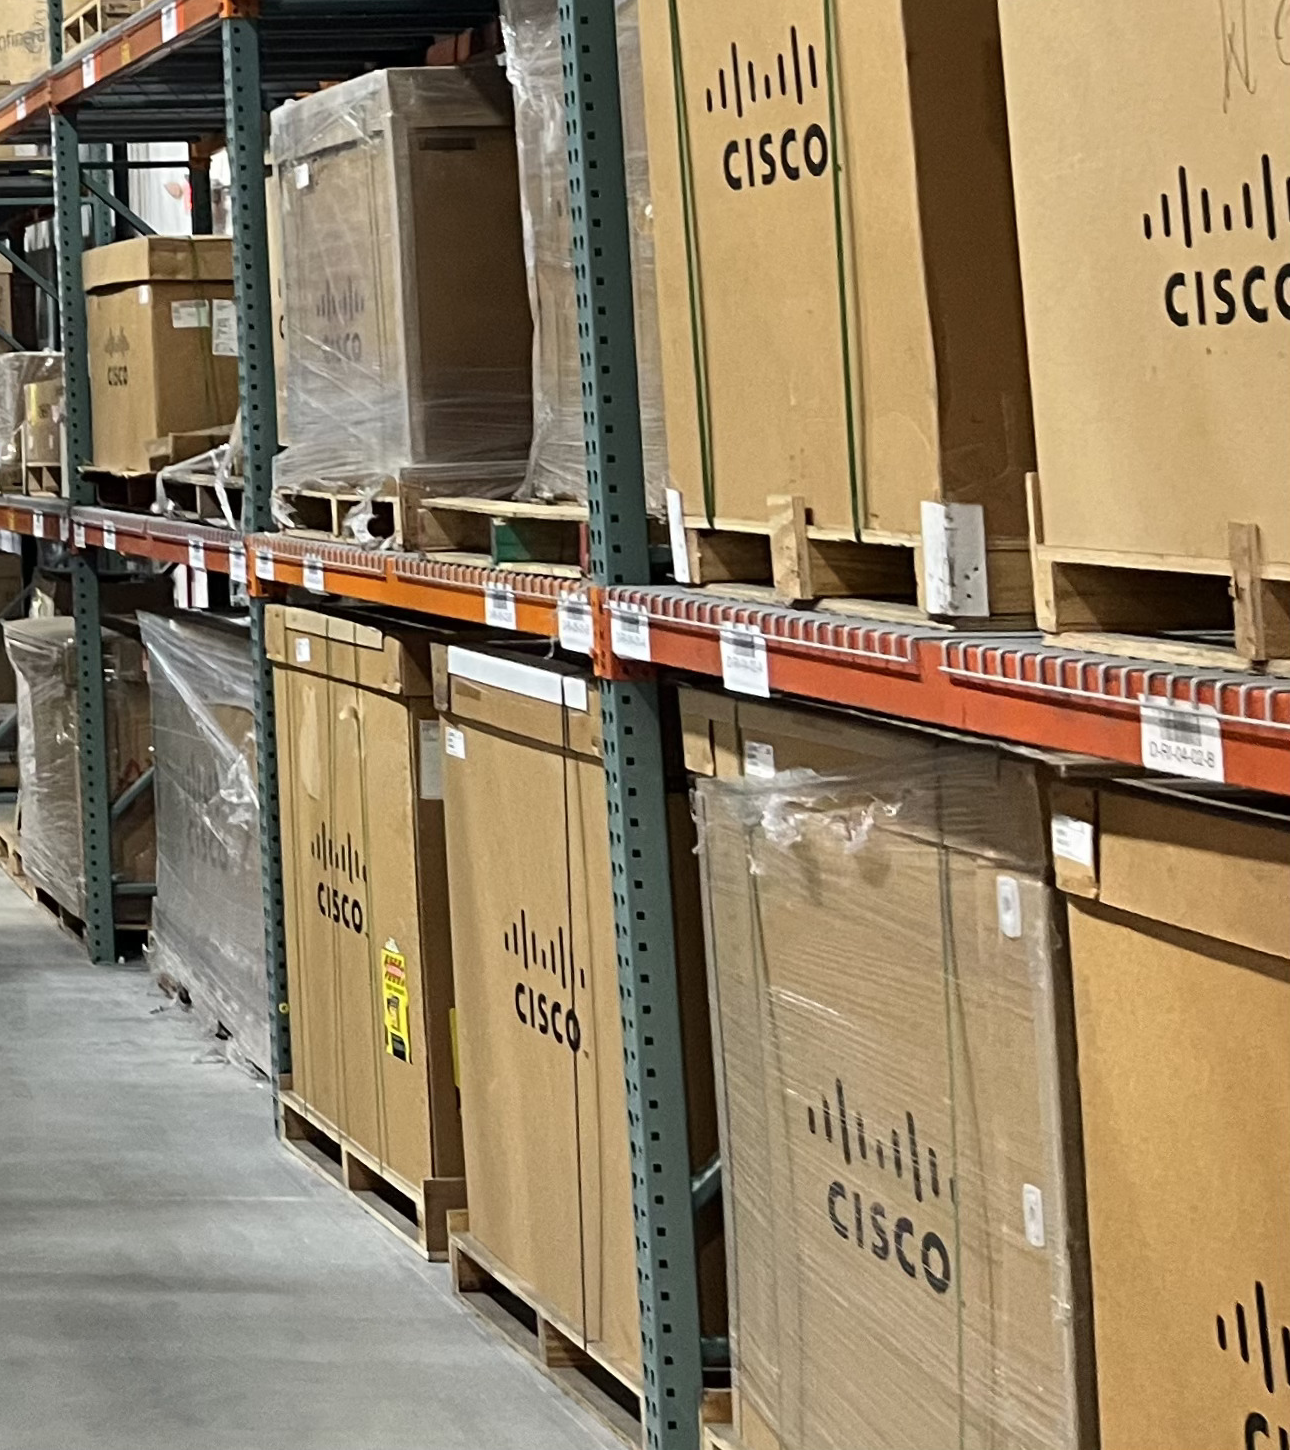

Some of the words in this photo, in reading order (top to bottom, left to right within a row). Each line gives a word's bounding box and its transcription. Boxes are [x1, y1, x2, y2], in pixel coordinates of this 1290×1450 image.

[723, 123, 828, 190] CISCO
[317, 881, 364, 935] CISCO
[514, 981, 581, 1053] CISCO
[827, 1180, 952, 1294] CISCO
